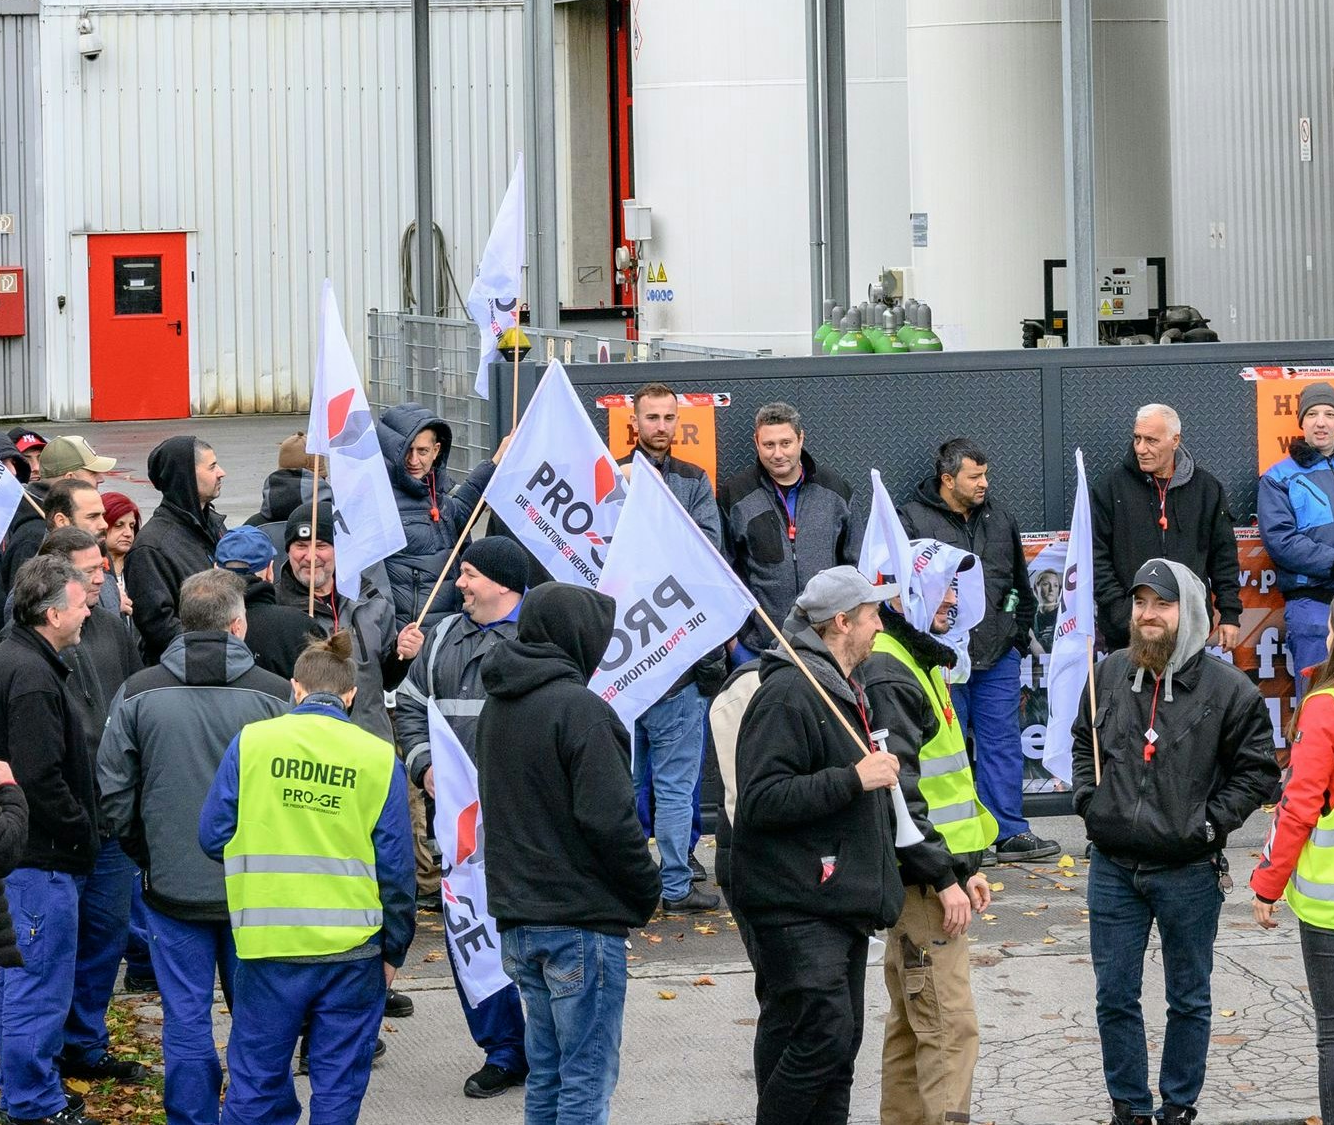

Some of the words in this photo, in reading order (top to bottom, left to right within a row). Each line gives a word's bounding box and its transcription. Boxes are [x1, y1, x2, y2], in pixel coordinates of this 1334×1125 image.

[515, 494, 531, 512] DIE
[526, 505, 601, 589] PRODUKTIONSGEWERKSC
[271, 757, 357, 789] ORDNER
[283, 788, 342, 809] PRO-GE
